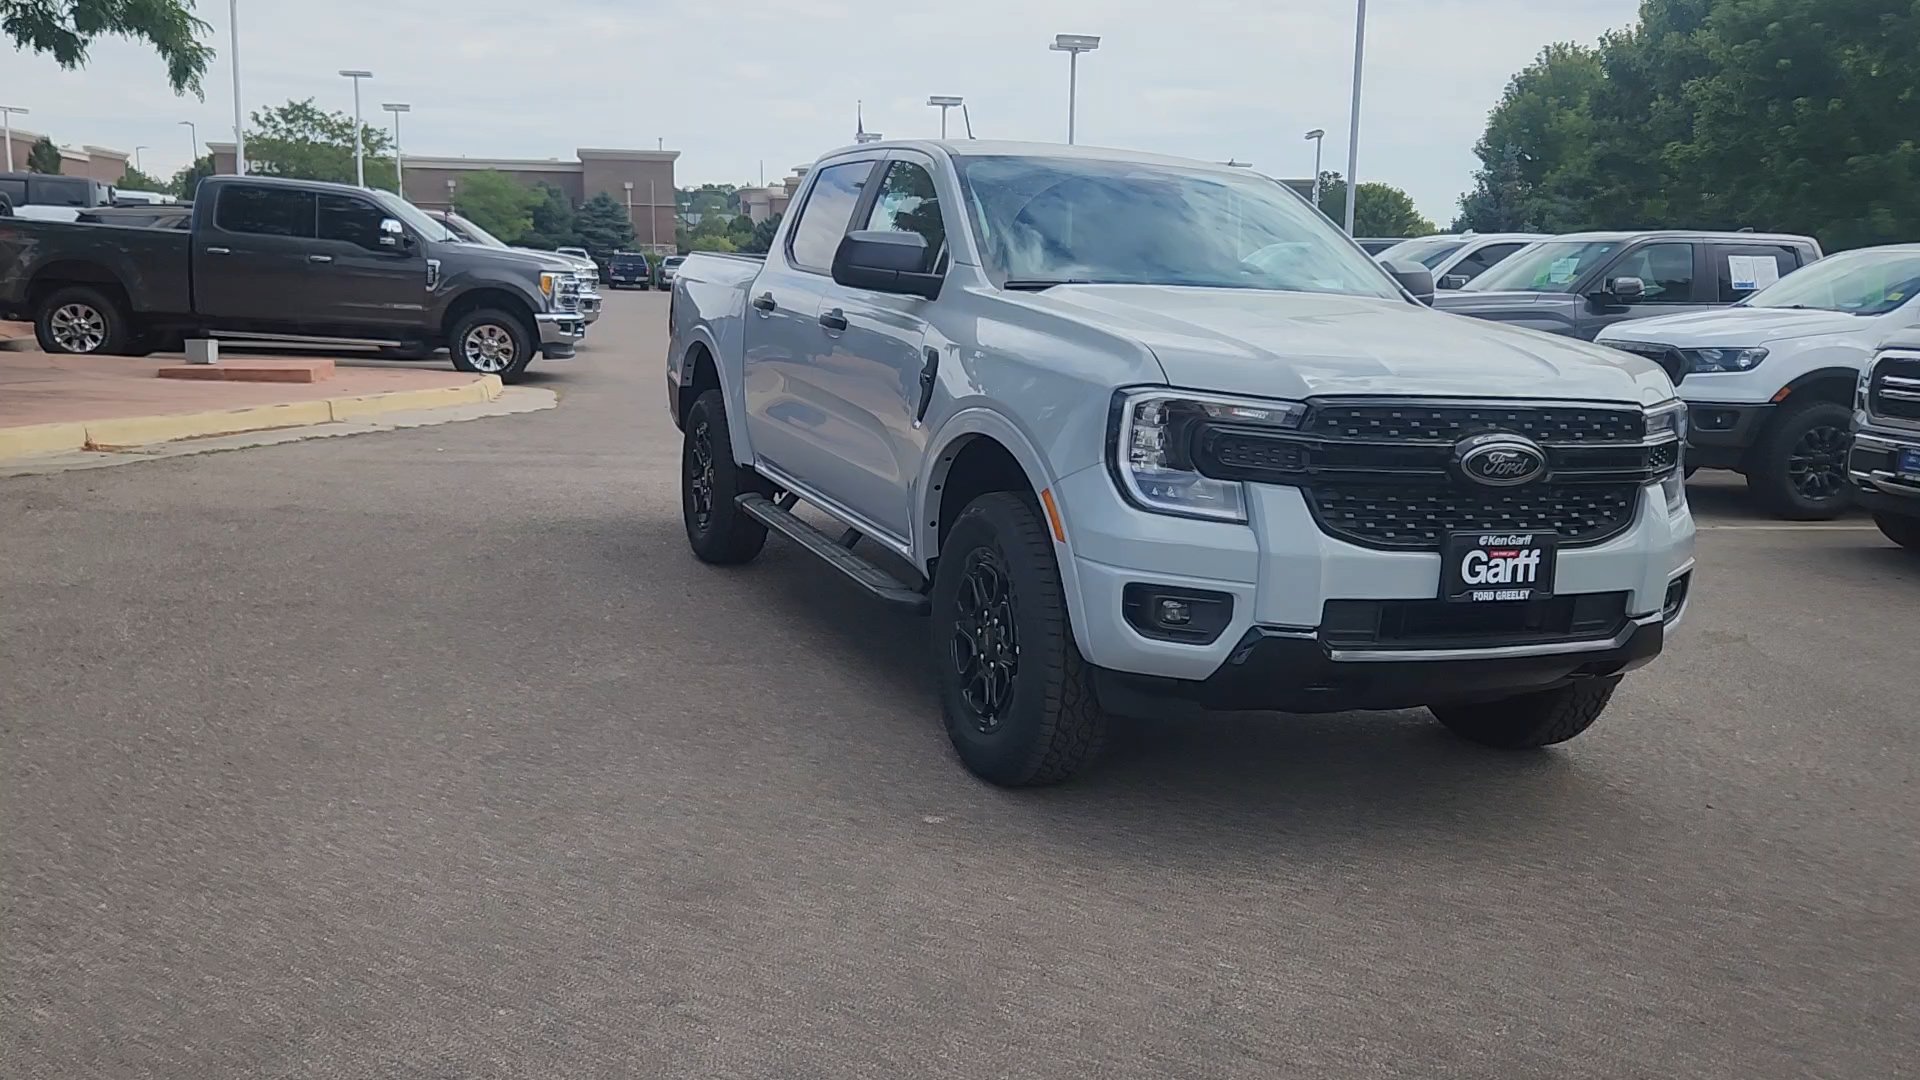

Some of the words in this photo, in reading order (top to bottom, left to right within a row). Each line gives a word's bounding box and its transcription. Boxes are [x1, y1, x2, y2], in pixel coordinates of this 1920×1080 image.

[1483, 451, 1529, 475] Ford
[1487, 536, 1507, 546] Ken
[1507, 534, 1532, 546] Garff
[1461, 549, 1541, 584] Garff
[1473, 592, 1494, 602] FORD
[1495, 590, 1530, 601] GREELEY
